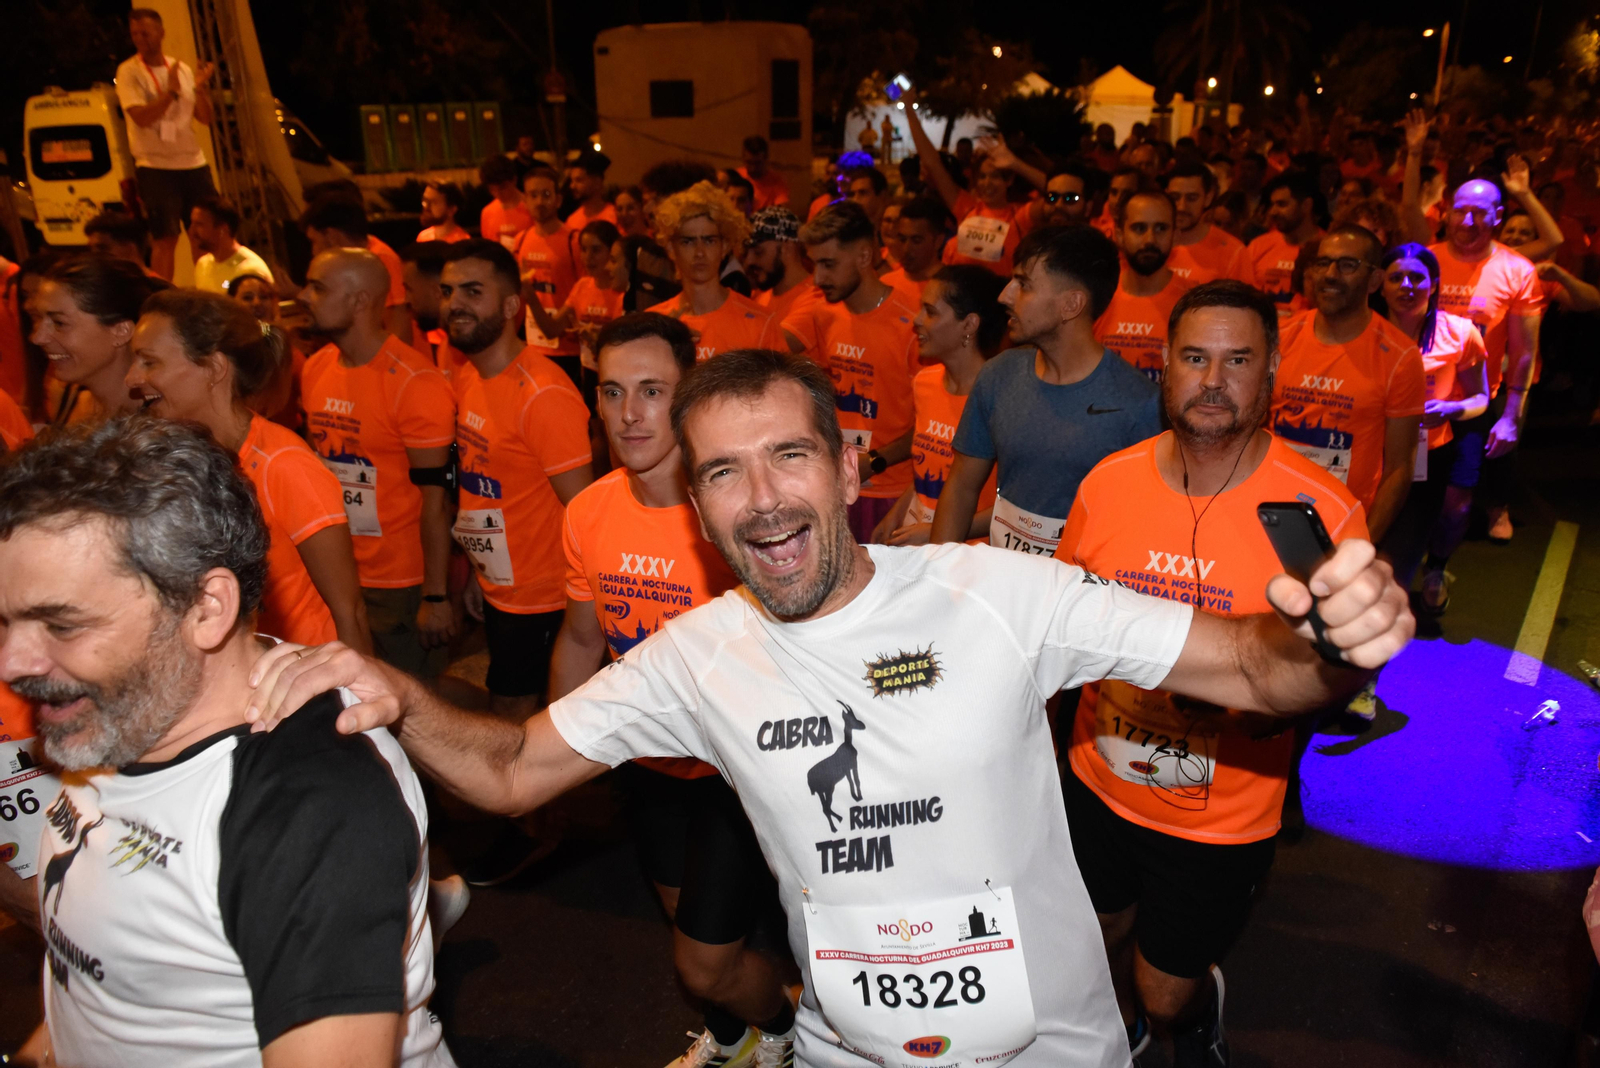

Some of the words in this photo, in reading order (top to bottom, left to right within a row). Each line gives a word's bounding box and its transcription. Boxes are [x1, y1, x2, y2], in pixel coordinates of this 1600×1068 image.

[966, 230, 996, 244] 20012
[1441, 284, 1477, 296] XXXV
[1116, 321, 1154, 336] XXXV
[836, 341, 866, 360] XXXV
[1300, 374, 1345, 392] XXXV
[323, 397, 355, 415] XXXV
[1285, 392, 1354, 410] GUADALQUIVIR
[465, 410, 486, 432] XXXV
[619, 552, 675, 579] XXXV
[1145, 550, 1216, 580] XXXV
[598, 572, 638, 586] CARRERA
[642, 578, 693, 595] NOCTURNA
[603, 583, 693, 607] GUADALQUIVIR
[1115, 569, 1167, 586] CARRERA
[1171, 578, 1235, 599] NOCTURNA
[1122, 580, 1232, 612] GUADALQUIVIR
[873, 658, 930, 679] DEPORTE
[882, 671, 927, 688] MANIA
[756, 715, 834, 752] CABRA
[1112, 715, 1190, 759] 17723
[850, 796, 943, 831] RUNNING
[815, 834, 895, 874] TEAM
[48, 916, 105, 983] RUNNING
[820, 951, 840, 959] XXXV
[840, 952, 870, 962] CARRERA
[869, 955, 908, 963] NOCTURNA
[921, 945, 975, 962] GUADALQUIVIR
[975, 942, 990, 952] KH7
[991, 940, 1009, 950] 2023
[852, 965, 986, 1009] 18328
